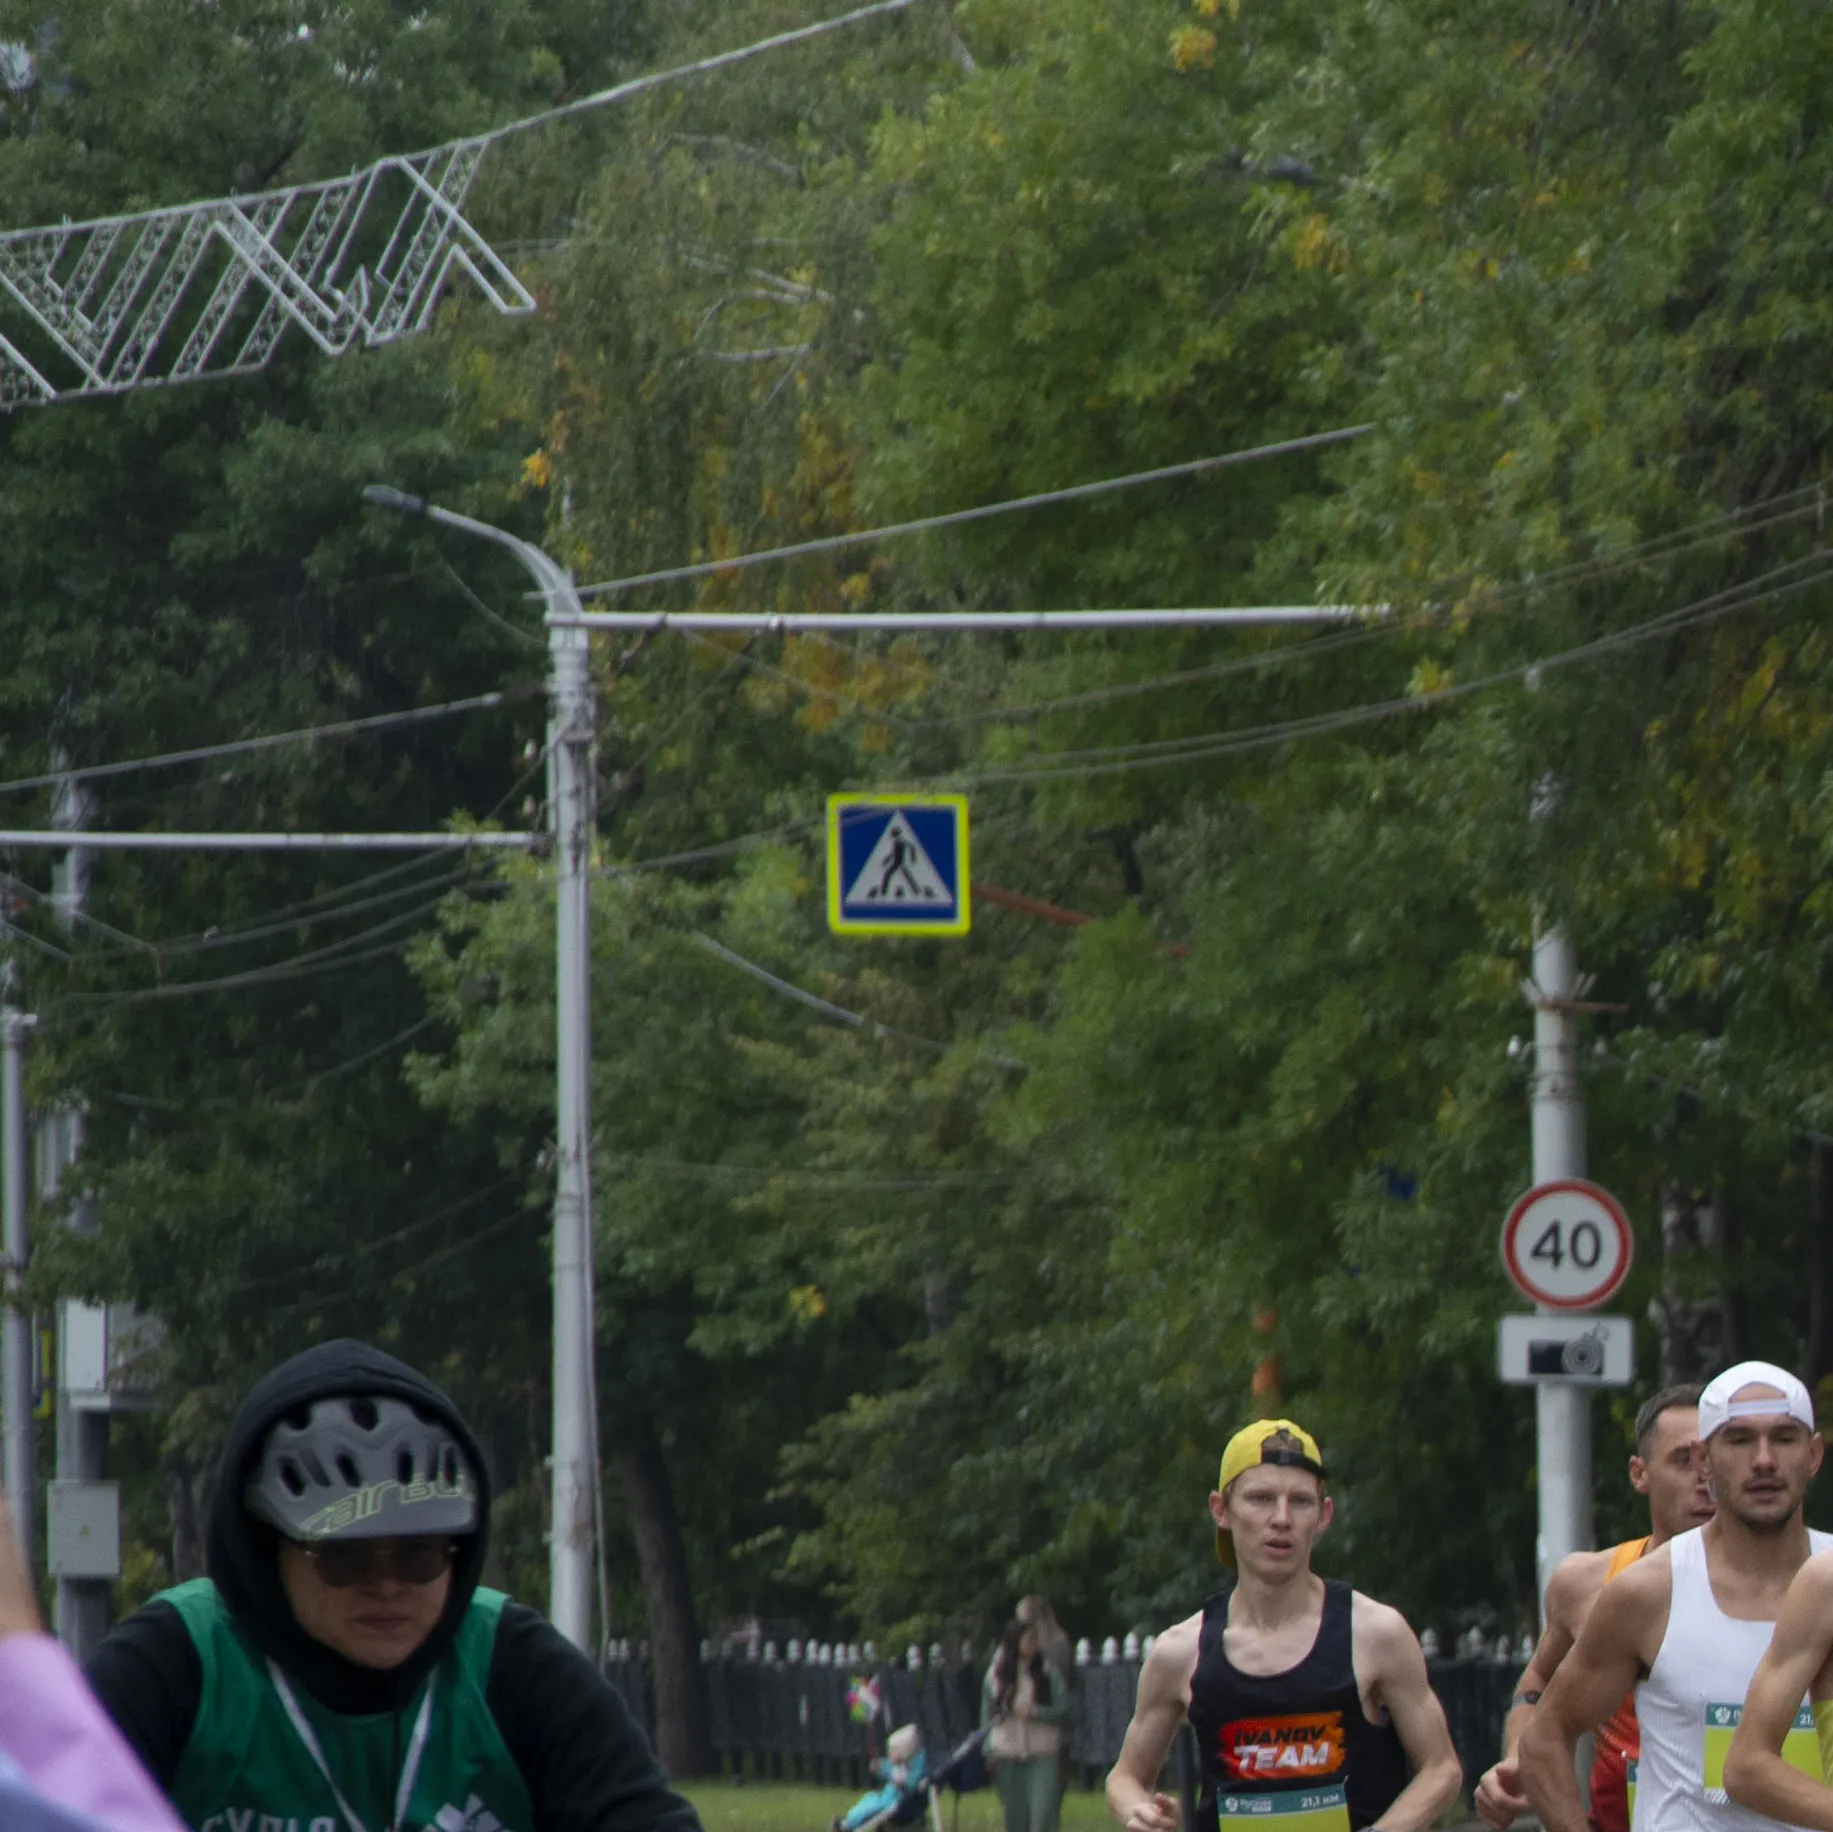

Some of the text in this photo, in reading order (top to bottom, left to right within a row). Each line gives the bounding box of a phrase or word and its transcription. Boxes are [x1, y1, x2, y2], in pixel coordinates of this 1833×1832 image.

[1530, 1219, 1601, 1270] 40
[1234, 1724, 1326, 1745] IVANOV
[1233, 1742, 1330, 1771] TEAM
